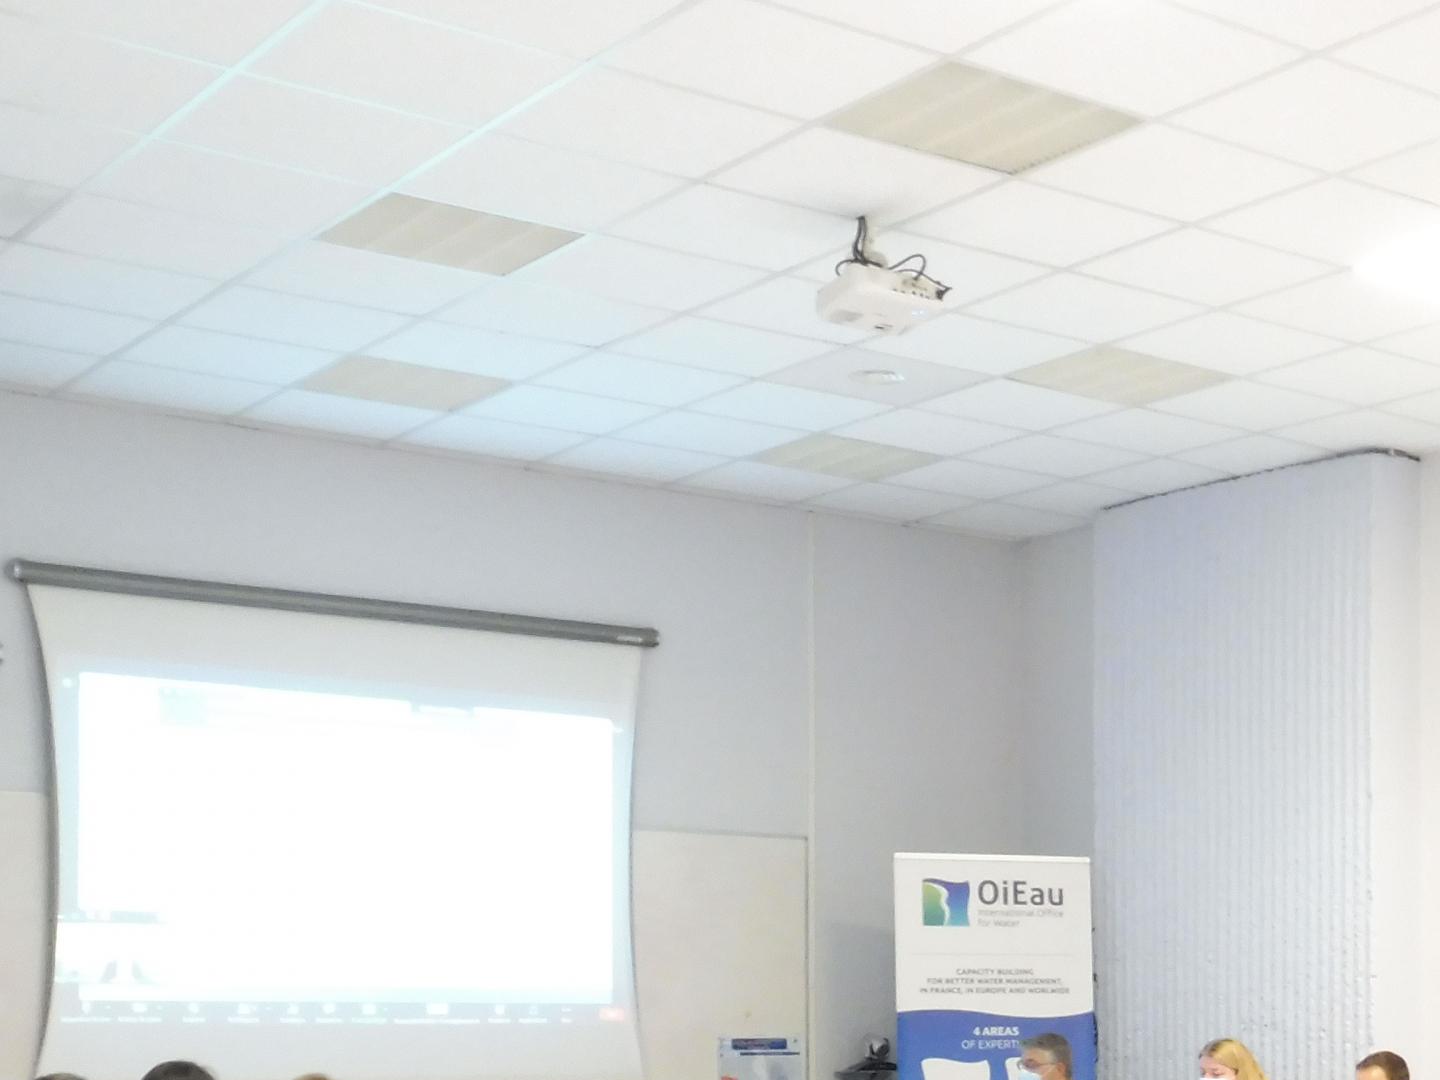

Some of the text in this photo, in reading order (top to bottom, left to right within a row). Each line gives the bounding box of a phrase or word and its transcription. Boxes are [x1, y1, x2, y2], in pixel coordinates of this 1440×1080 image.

[978, 880, 1064, 906] OiEau
[956, 968, 1034, 976] CAPACITY BUILDING
[976, 987, 1006, 995] EUROPE
[1009, 987, 1026, 995] AND
[973, 1027, 1020, 1036] 4 AREAS
[961, 1040, 976, 1049] OF
